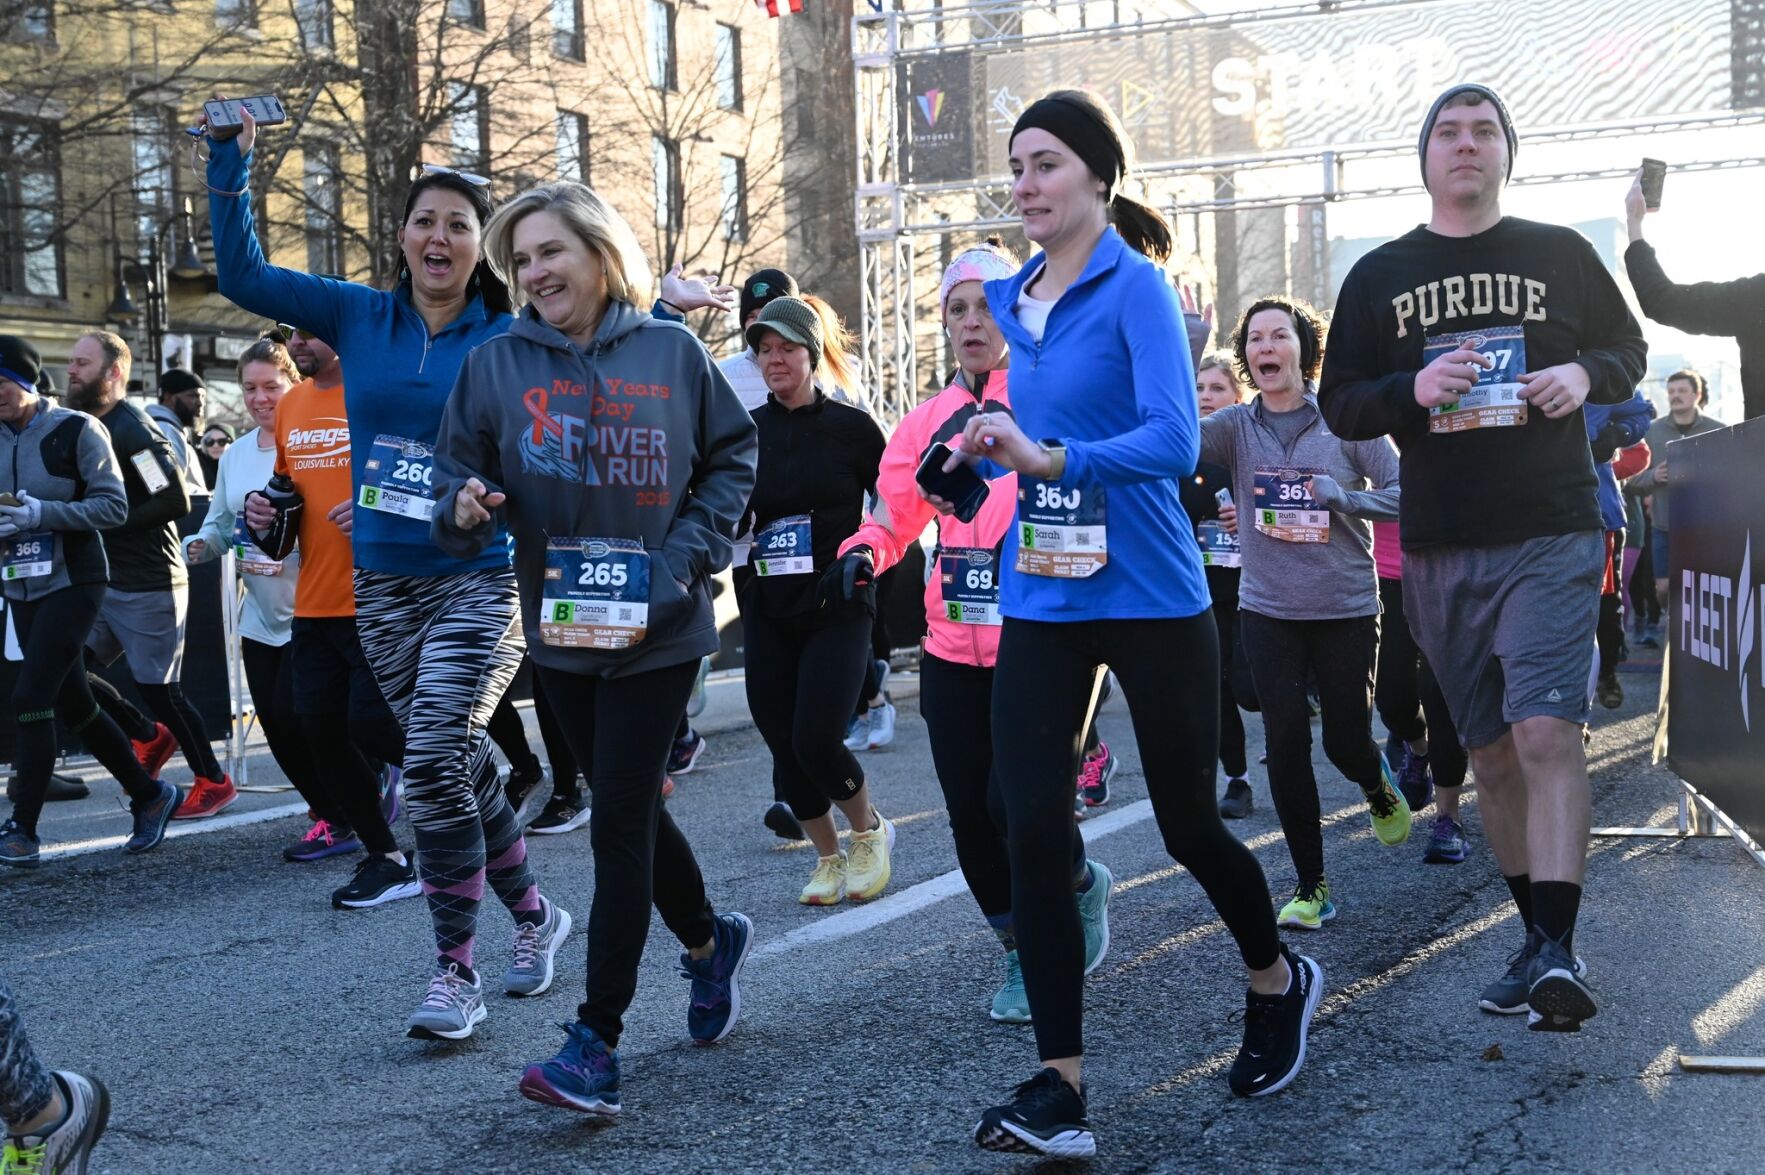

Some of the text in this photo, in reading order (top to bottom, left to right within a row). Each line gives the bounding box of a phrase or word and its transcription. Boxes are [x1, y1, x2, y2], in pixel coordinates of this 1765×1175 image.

[1211, 40, 1446, 116] START
[1392, 273, 1547, 338] PURDUE
[606, 378, 670, 399] Years
[591, 396, 635, 422] Day
[286, 427, 350, 448] Swags
[337, 457, 351, 467] KY
[608, 456, 668, 487] RUN
[366, 489, 376, 504] B
[1264, 512, 1273, 524] B
[767, 532, 798, 549] 263
[1024, 527, 1031, 546] B
[1035, 529, 1060, 540] Sarah
[1215, 532, 1240, 546] 152
[16, 541, 41, 556] 366
[8, 567, 14, 577] B
[578, 562, 628, 586] 265
[761, 561, 767, 574] B
[966, 569, 999, 590] 69
[555, 604, 569, 620] B
[575, 604, 607, 614] Donna
[949, 604, 985, 619] B Dana
[1682, 569, 1731, 671] FLEET
